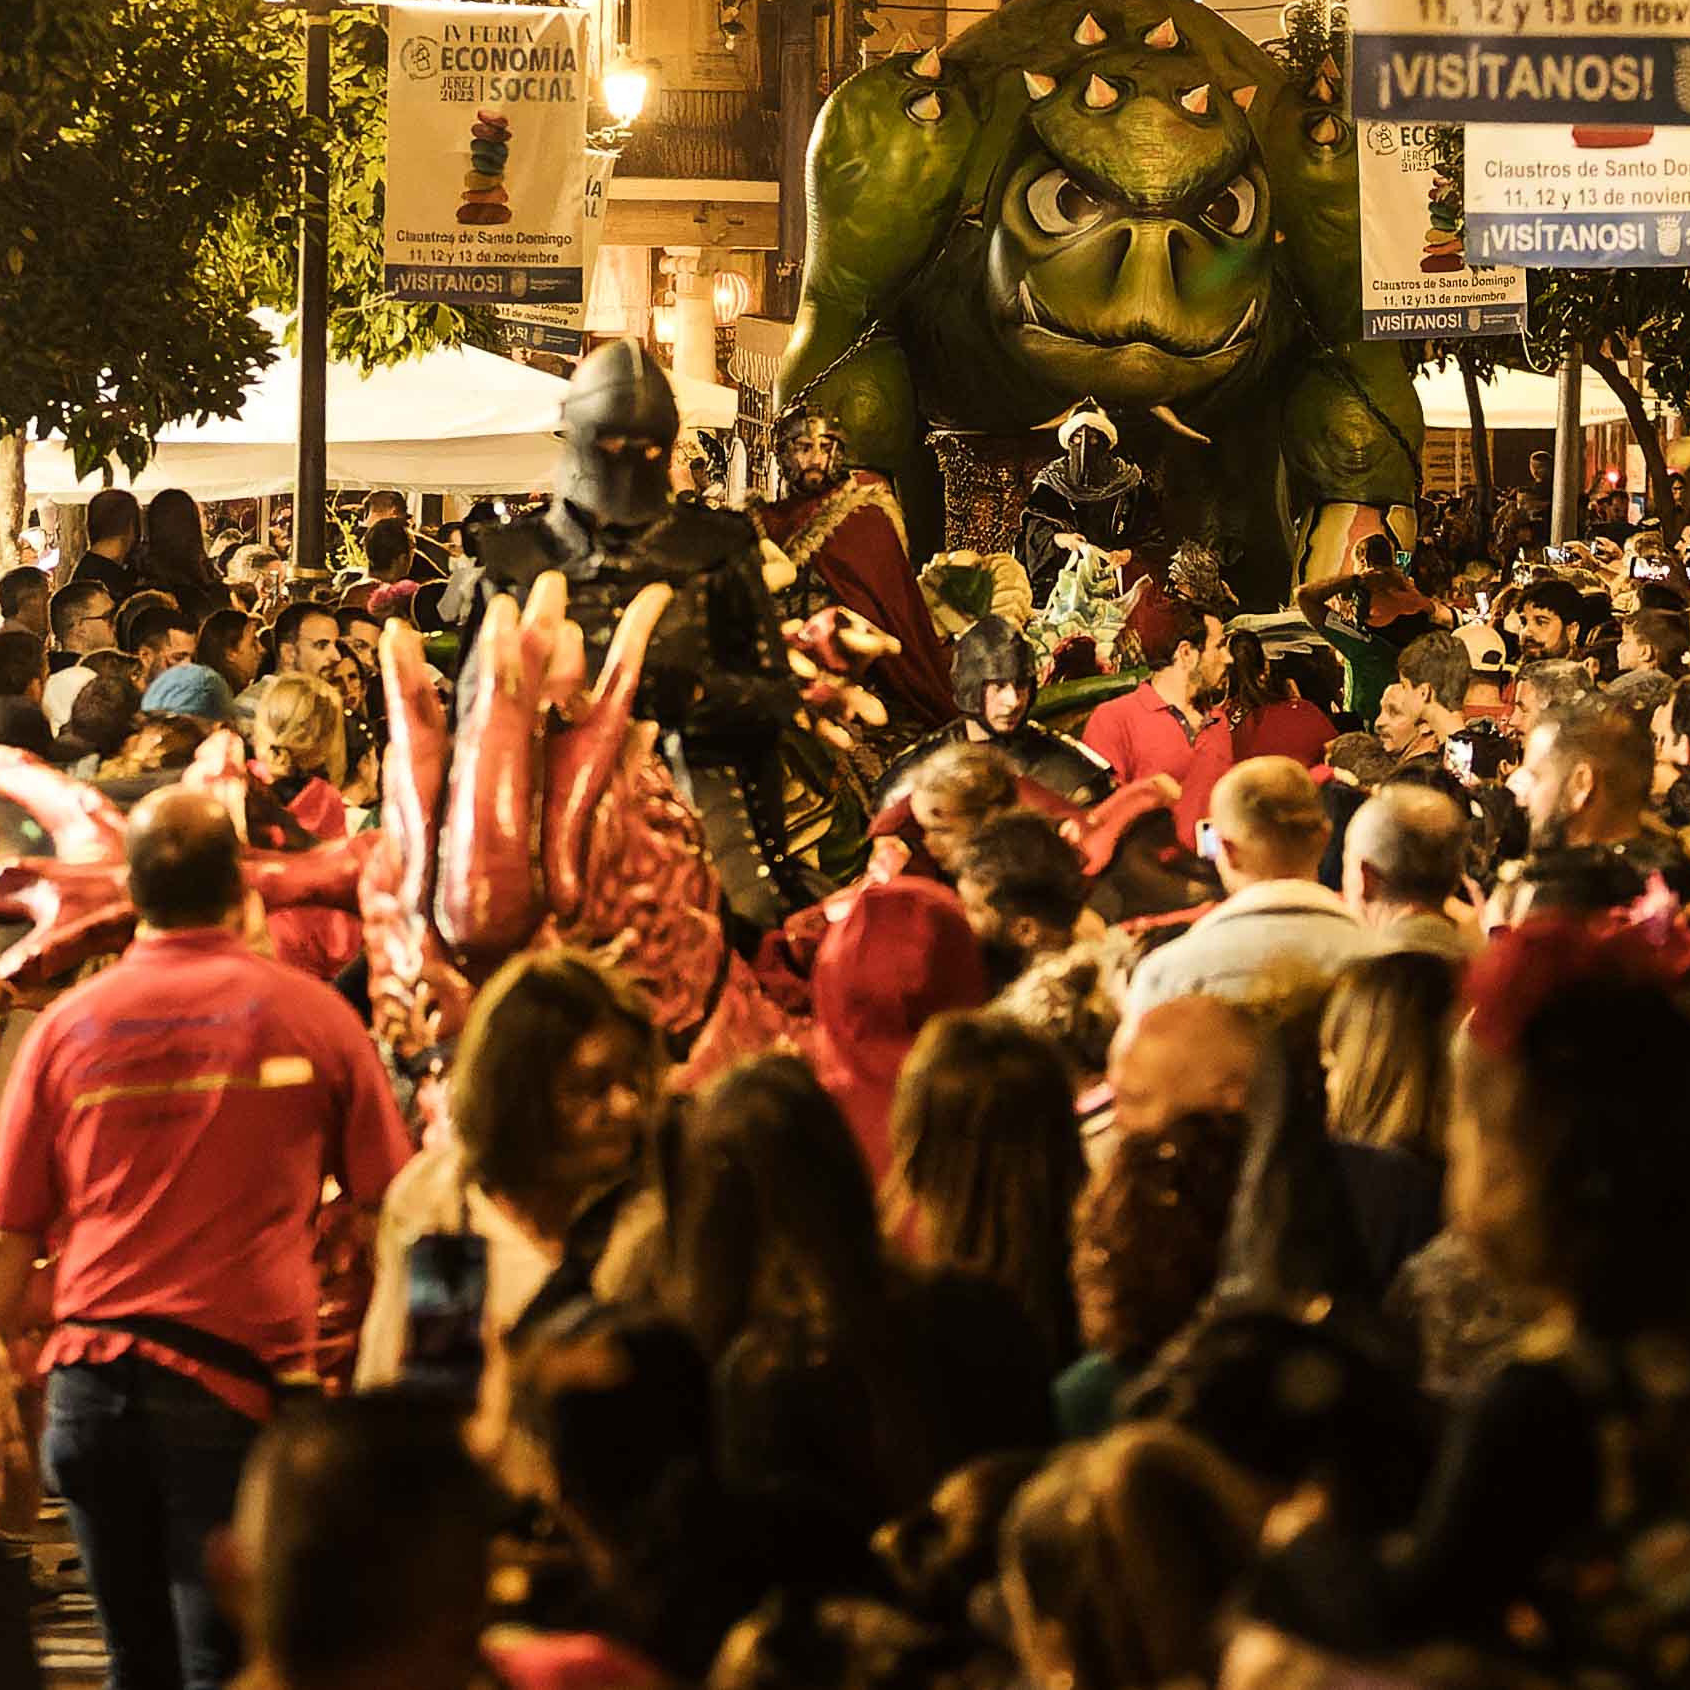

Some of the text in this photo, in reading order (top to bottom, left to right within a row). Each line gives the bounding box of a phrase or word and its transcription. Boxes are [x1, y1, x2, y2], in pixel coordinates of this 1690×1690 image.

[1511, 0, 1530, 33] y
[469, 25, 535, 44] FERIA
[440, 41, 577, 73] ECONOMÍA
[1379, 43, 1655, 110] ¡VISÍTANOS!
[488, 76, 577, 103] SOCIAL
[1401, 161, 1430, 172] 2022
[1484, 160, 1572, 179] Claustros
[1577, 159, 1599, 178] de
[1605, 160, 1657, 177] Santo
[1503, 189, 1529, 208] 11,
[1536, 189, 1556, 206] 12
[1562, 193, 1572, 210] y
[1579, 188, 1598, 206] 13
[1603, 188, 1625, 206] de
[396, 229, 572, 247] Claustros de Santo Domingo
[1481, 217, 1646, 258] ¡VISÍTANOS!
[431, 250, 444, 262] 12
[446, 252, 455, 265] y
[460, 250, 472, 263] 13
[476, 251, 491, 263] de
[493, 250, 559, 264] noviembre
[1372, 275, 1516, 291] Claustros de Santo Domingo
[1401, 295, 1412, 306] 12
[1414, 297, 1422, 308] y
[1424, 294, 1436, 305] 13
[1438, 294, 1451, 304] de
[1454, 291, 1506, 303] noviembre
[1371, 312, 1463, 335] ¡VISÍTANOS!
